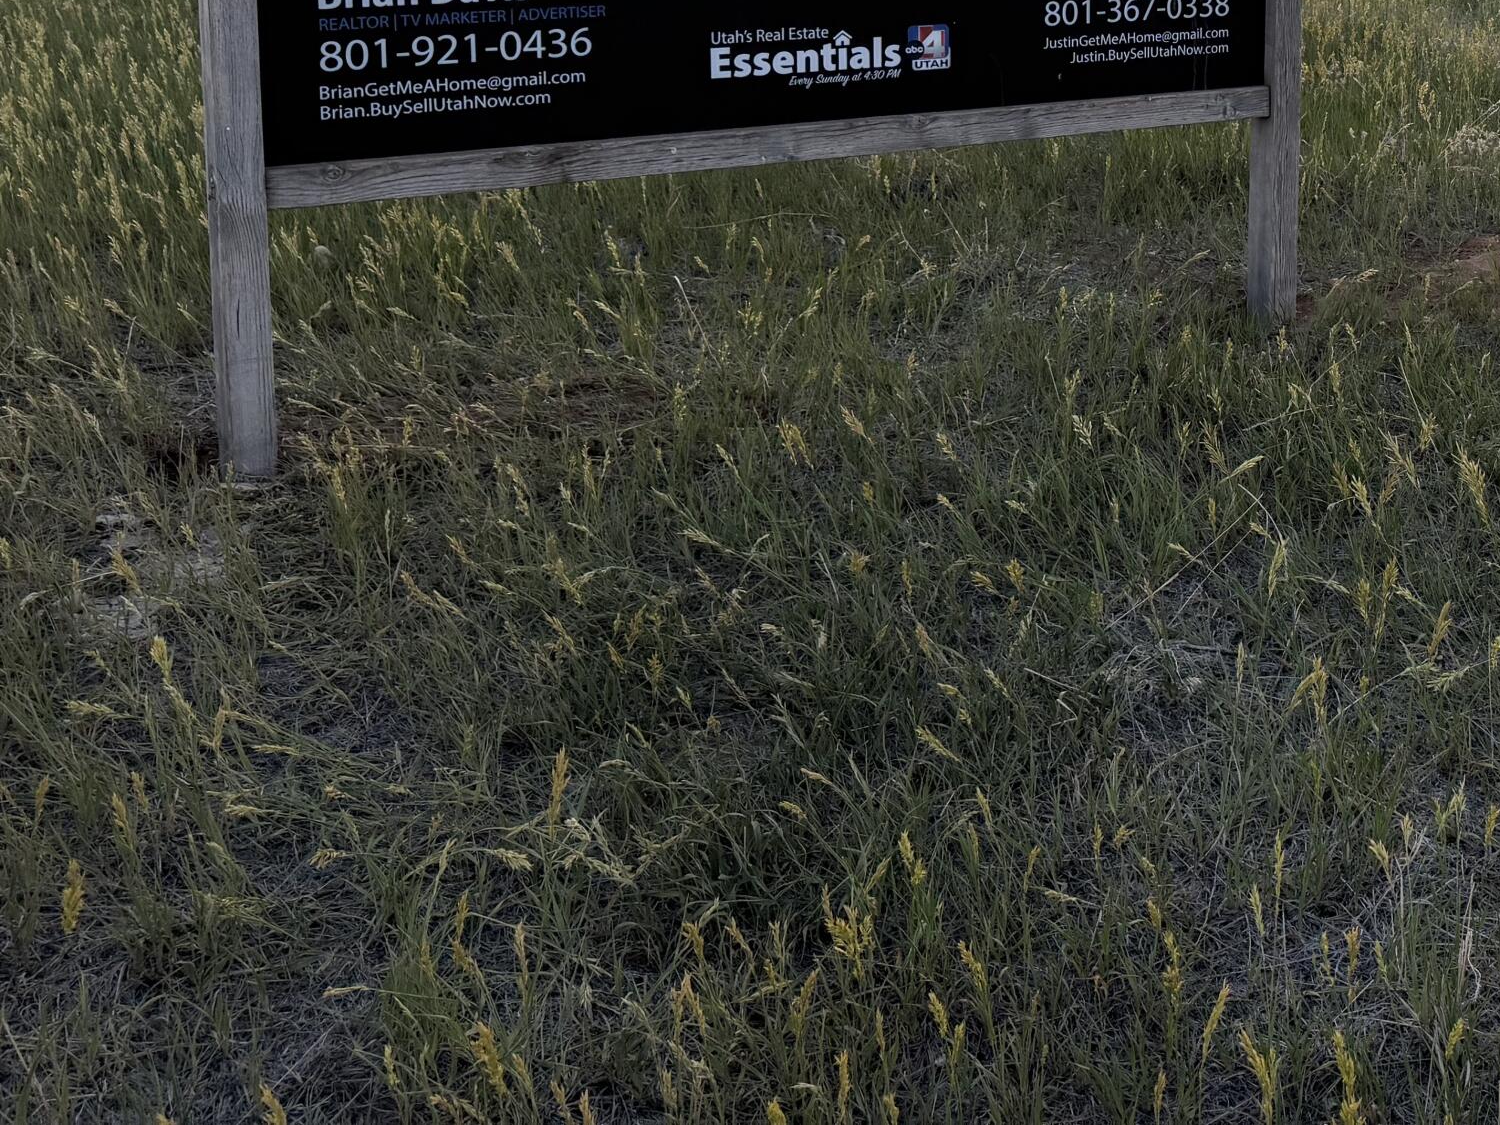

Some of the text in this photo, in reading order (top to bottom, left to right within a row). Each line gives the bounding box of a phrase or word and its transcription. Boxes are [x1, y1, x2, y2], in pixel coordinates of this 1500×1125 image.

[318, 14, 390, 31] REALTOR
[400, 13, 421, 28] TV
[425, 9, 506, 26] MARKETER
[518, 5, 606, 22] ADVERTISER
[756, 27, 785, 42] Real
[788, 27, 829, 40] Estate
[922, 30, 945, 58] 4
[1043, 27, 1230, 50] JustinGetMeAHome@gmail.com
[319, 27, 593, 72] 801-921-0436
[709, 36, 901, 79] Essentials
[1070, 43, 1230, 64] Justin.BuySellUtahNow.com
[914, 59, 949, 70] UTAH
[319, 71, 586, 101] BrianGetMeAHome@gmail.com
[788, 74, 813, 89] Every
[815, 72, 850, 86] Sunday
[851, 71, 862, 82] at
[886, 68, 902, 79] PM
[319, 91, 551, 121] Brian.BuySellUtahNow.com
